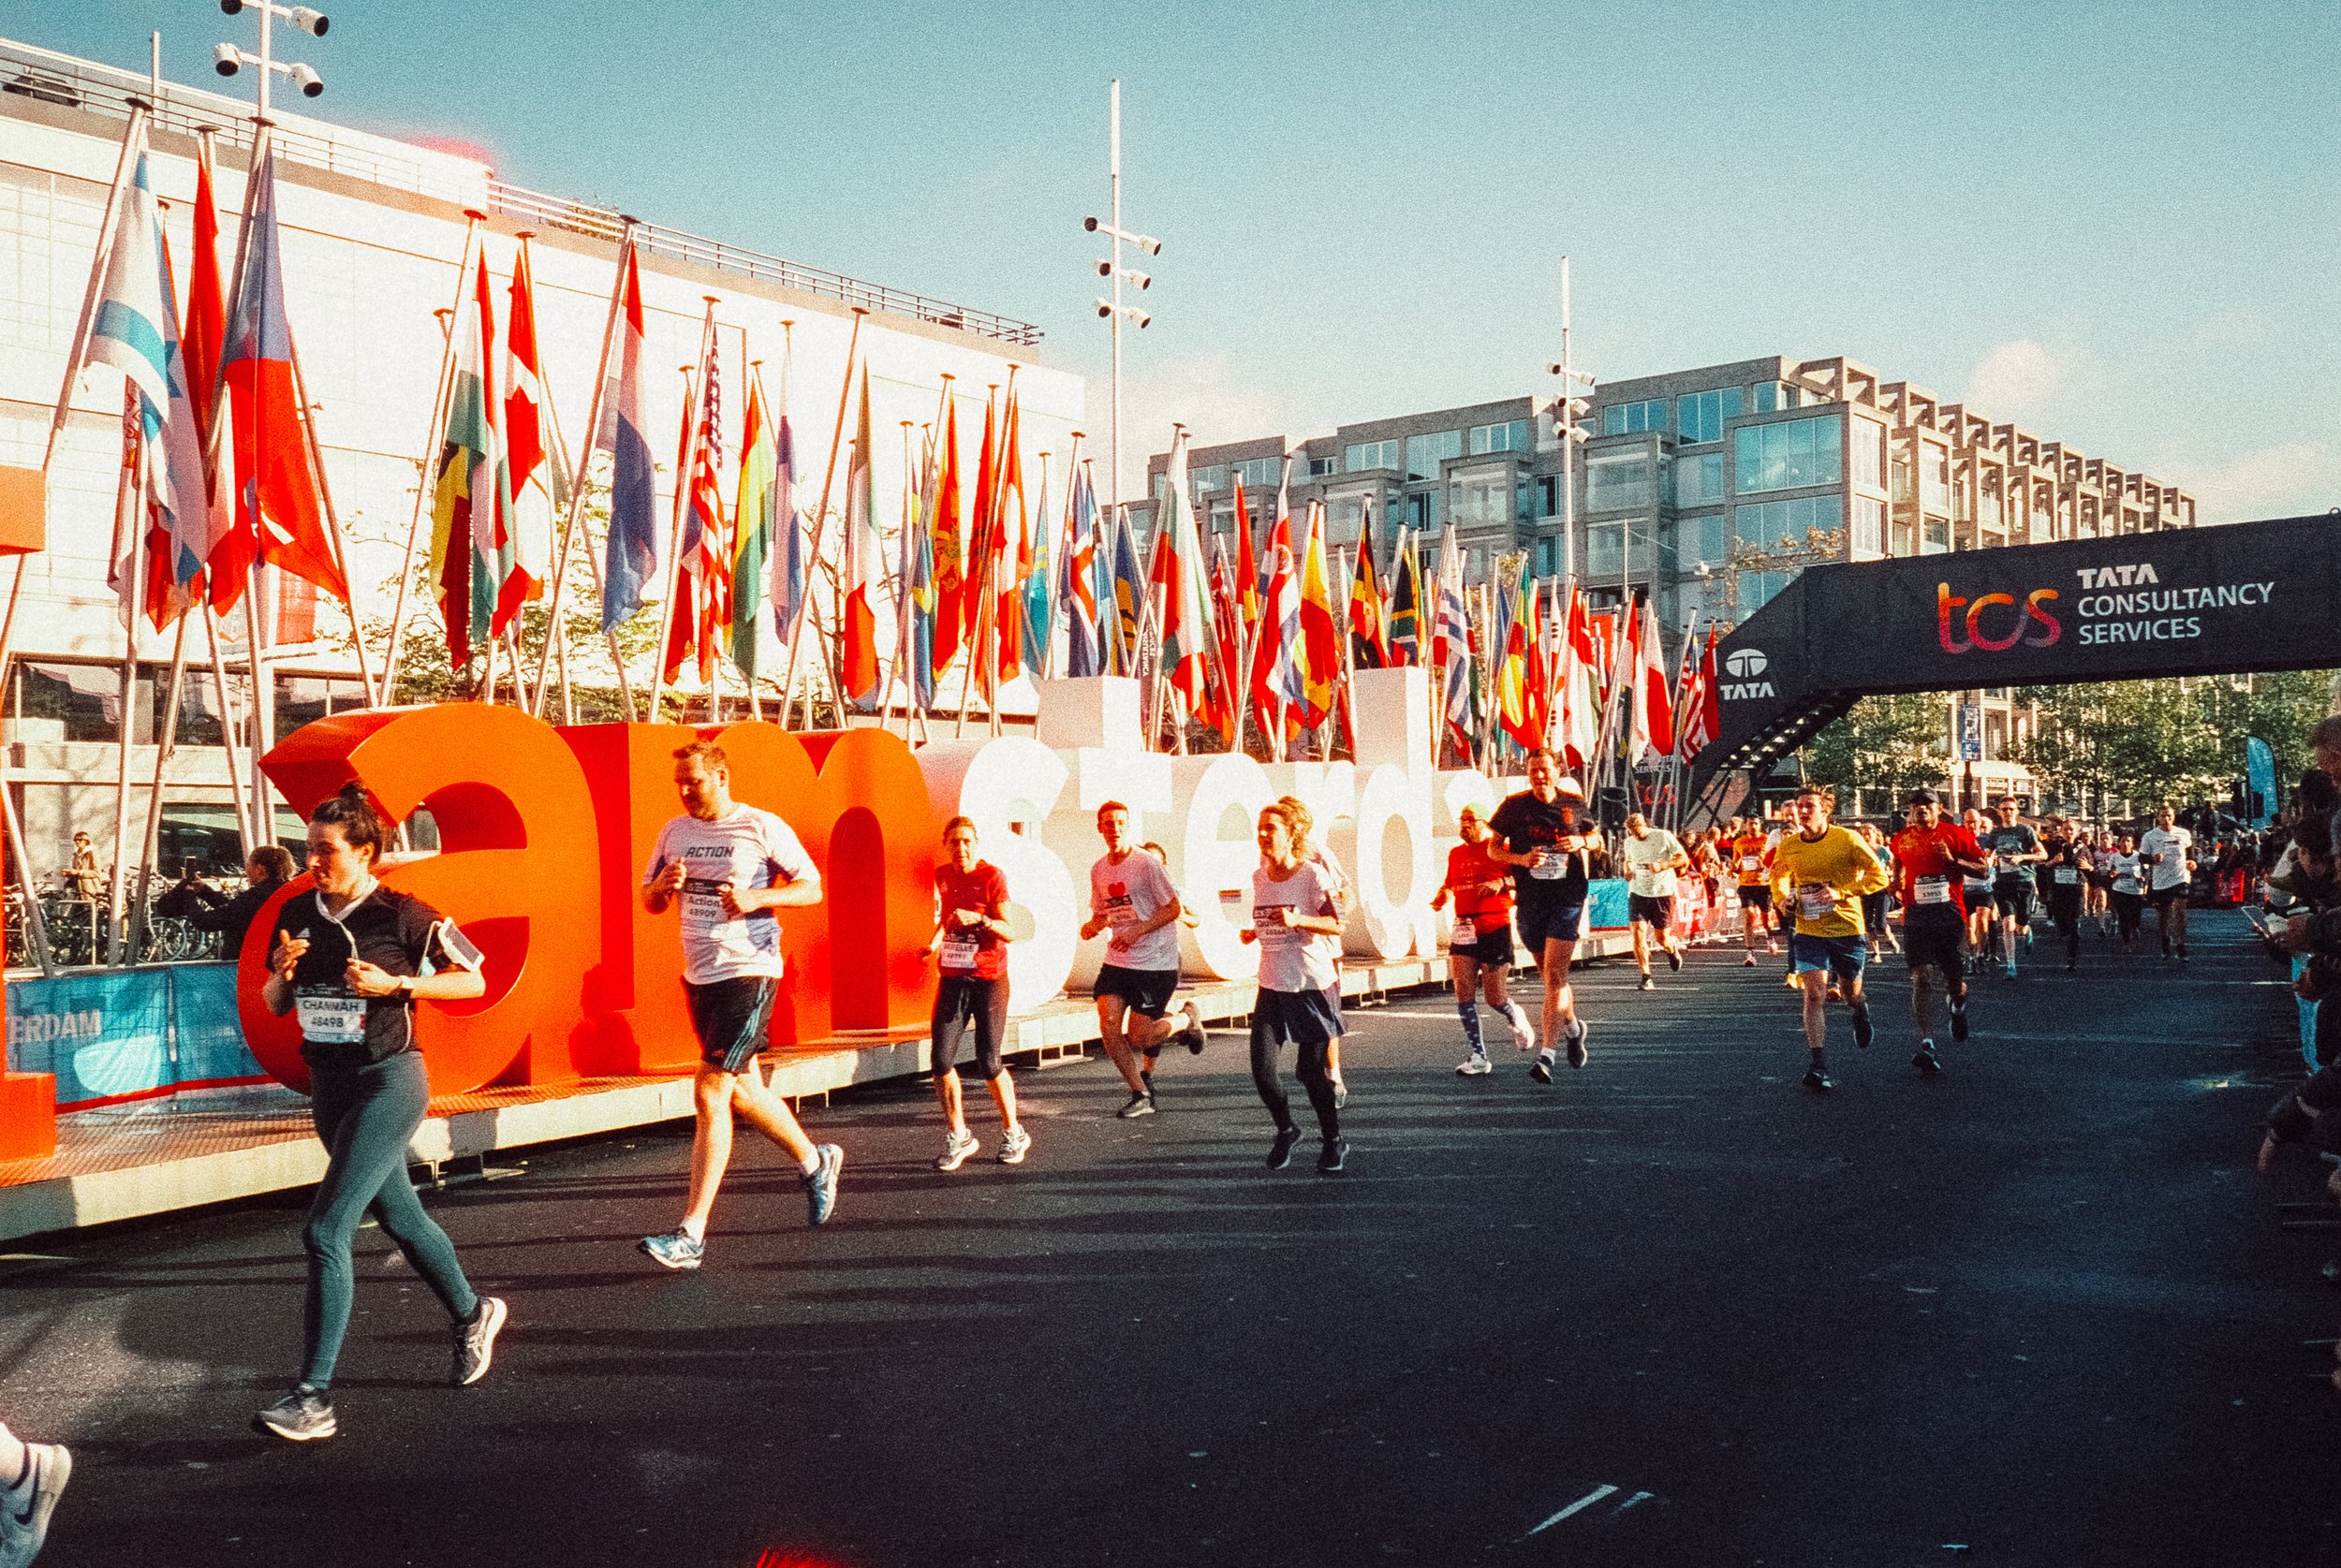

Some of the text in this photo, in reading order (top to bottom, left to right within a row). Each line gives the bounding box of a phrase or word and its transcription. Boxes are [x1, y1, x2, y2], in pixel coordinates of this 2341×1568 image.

[2077, 564, 2158, 590] TATA
[2078, 581, 2275, 618] CONSULTANCY
[1937, 582, 2062, 654] tcs
[2079, 617, 2201, 645] SERVICES
[1720, 681, 1775, 701] TATA
[685, 846, 734, 857] ACTION
[688, 896, 720, 908] Action
